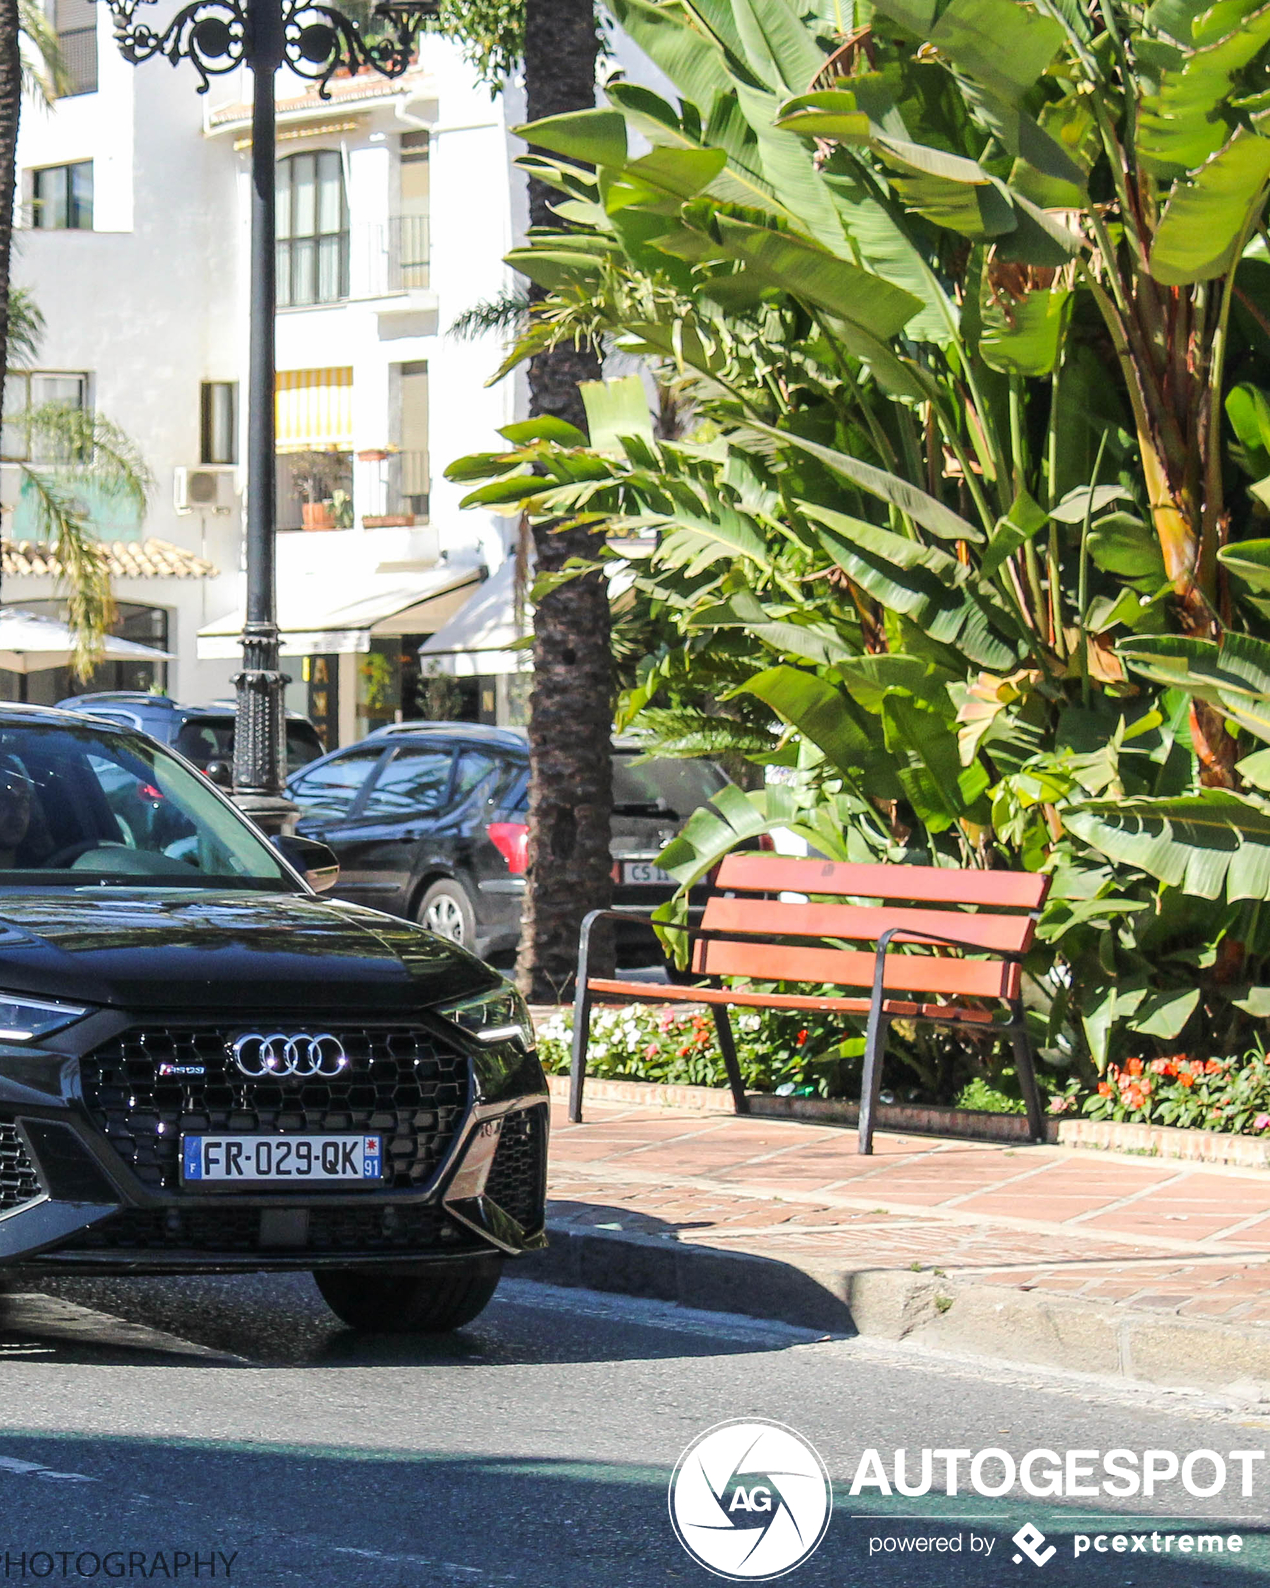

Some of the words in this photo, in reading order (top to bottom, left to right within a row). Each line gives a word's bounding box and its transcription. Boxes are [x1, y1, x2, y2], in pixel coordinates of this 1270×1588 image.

[190, 1163, 196, 1173] F
[204, 1141, 359, 1176] FR-029-QK
[364, 1159, 378, 1176] 91
